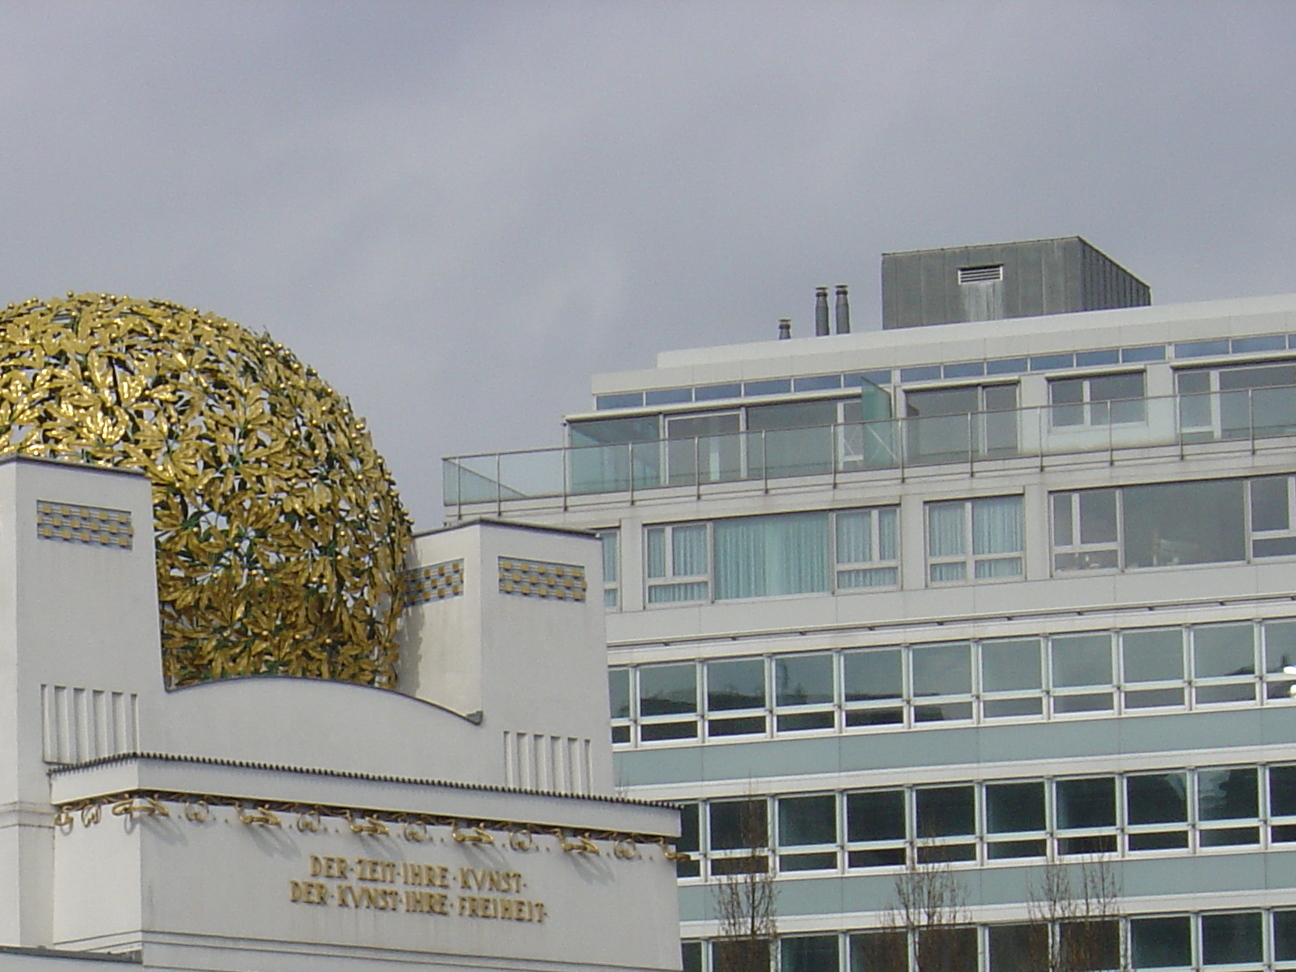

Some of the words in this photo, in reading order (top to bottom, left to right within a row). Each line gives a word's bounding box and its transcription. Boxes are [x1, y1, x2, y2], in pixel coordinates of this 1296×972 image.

[309, 855, 347, 879] DER
[355, 858, 396, 883] ZEIT
[403, 862, 450, 888] IHRE
[289, 880, 328, 905] DER
[405, 889, 450, 915] IHRE
[457, 895, 545, 923] FREIHEIT
